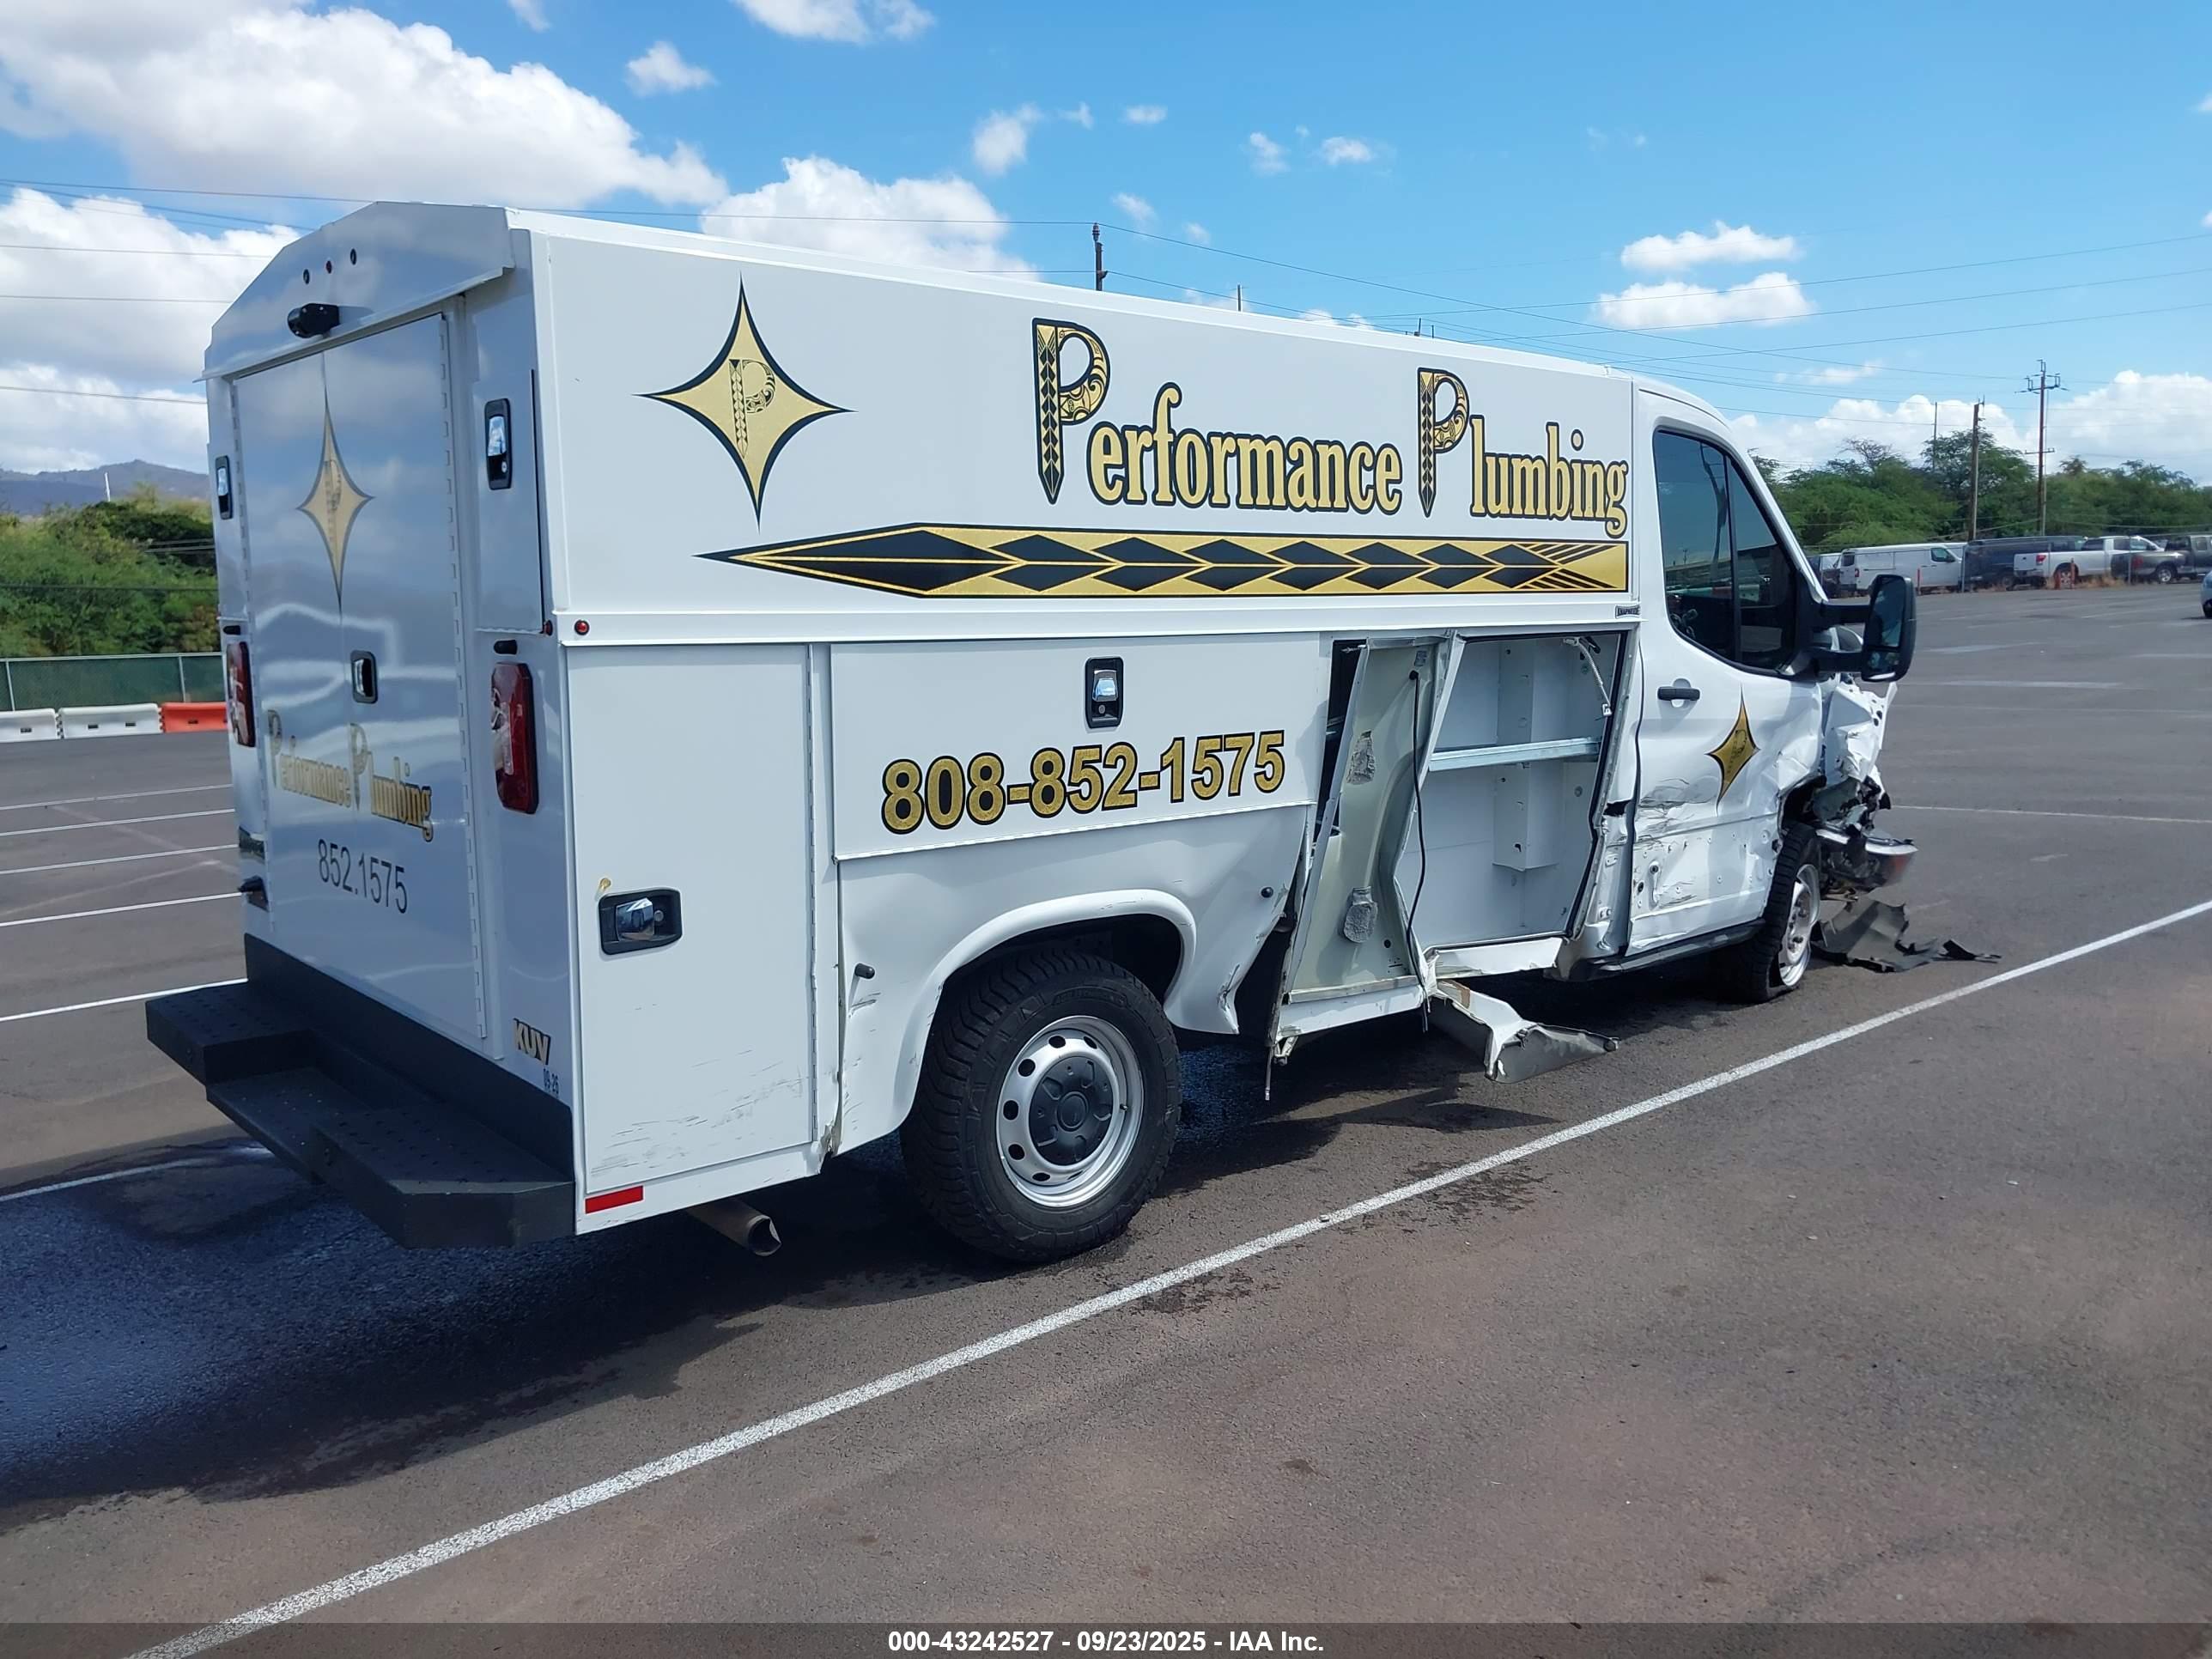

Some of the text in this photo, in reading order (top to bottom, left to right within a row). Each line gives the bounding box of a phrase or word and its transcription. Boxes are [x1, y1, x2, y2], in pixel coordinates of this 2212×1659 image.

[1031, 318, 1628, 538] Performance Plumbing
[267, 710, 434, 842] Performance Plumbing
[881, 730, 1285, 834] 808-852-1575
[318, 839, 408, 914] 852.1575
[513, 1018, 551, 1066] KUV
